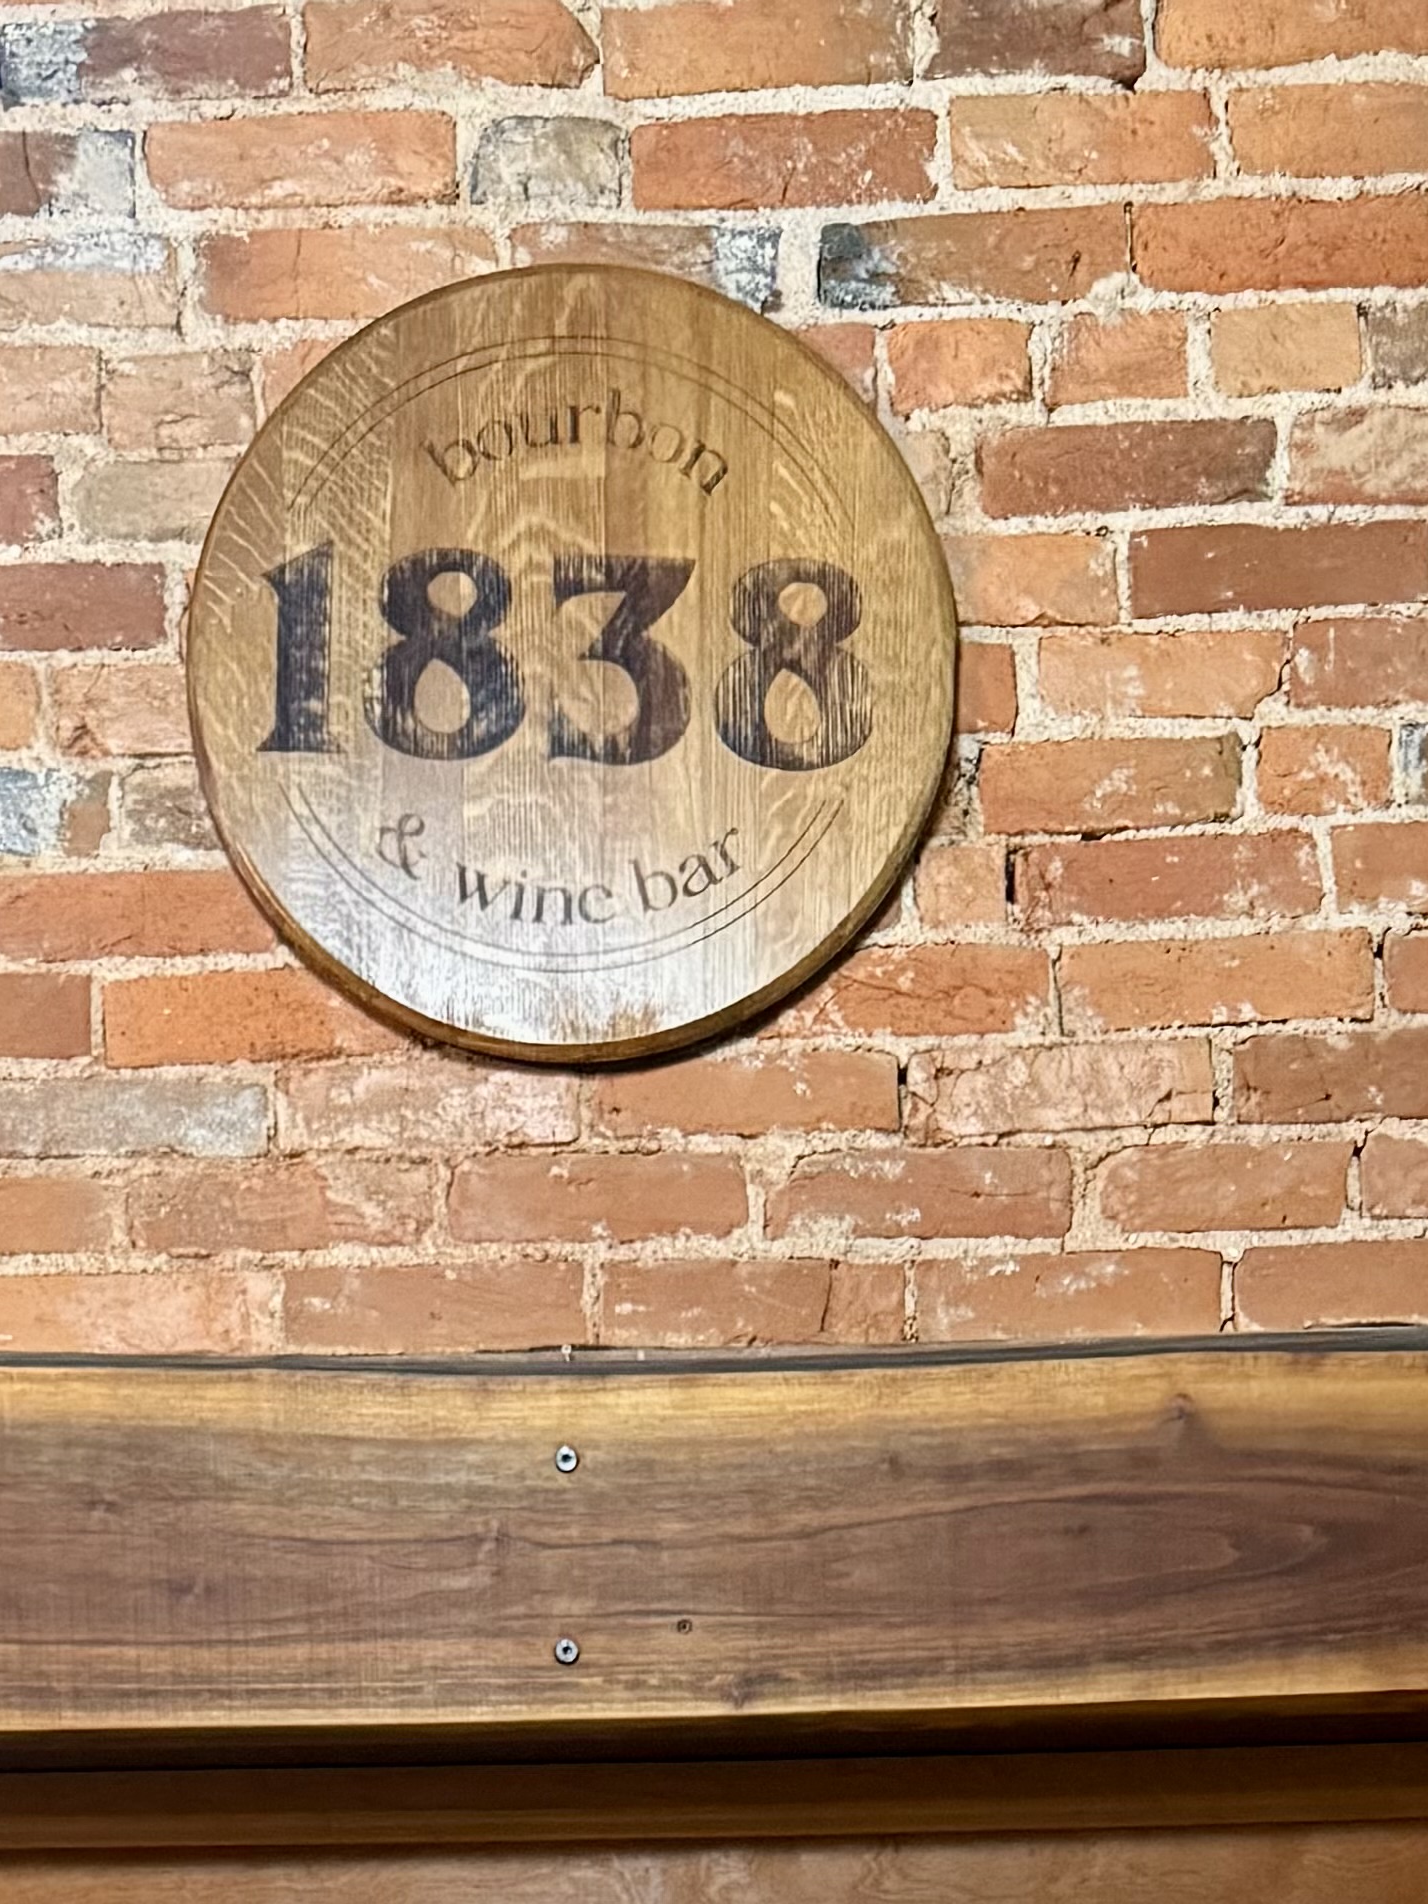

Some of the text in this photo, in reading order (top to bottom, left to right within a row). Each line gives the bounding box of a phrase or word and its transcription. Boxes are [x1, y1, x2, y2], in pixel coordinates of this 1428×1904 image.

[420, 388, 729, 498] bourbon
[256, 538, 874, 773] 1838
[377, 812, 744, 926] & wine bar
